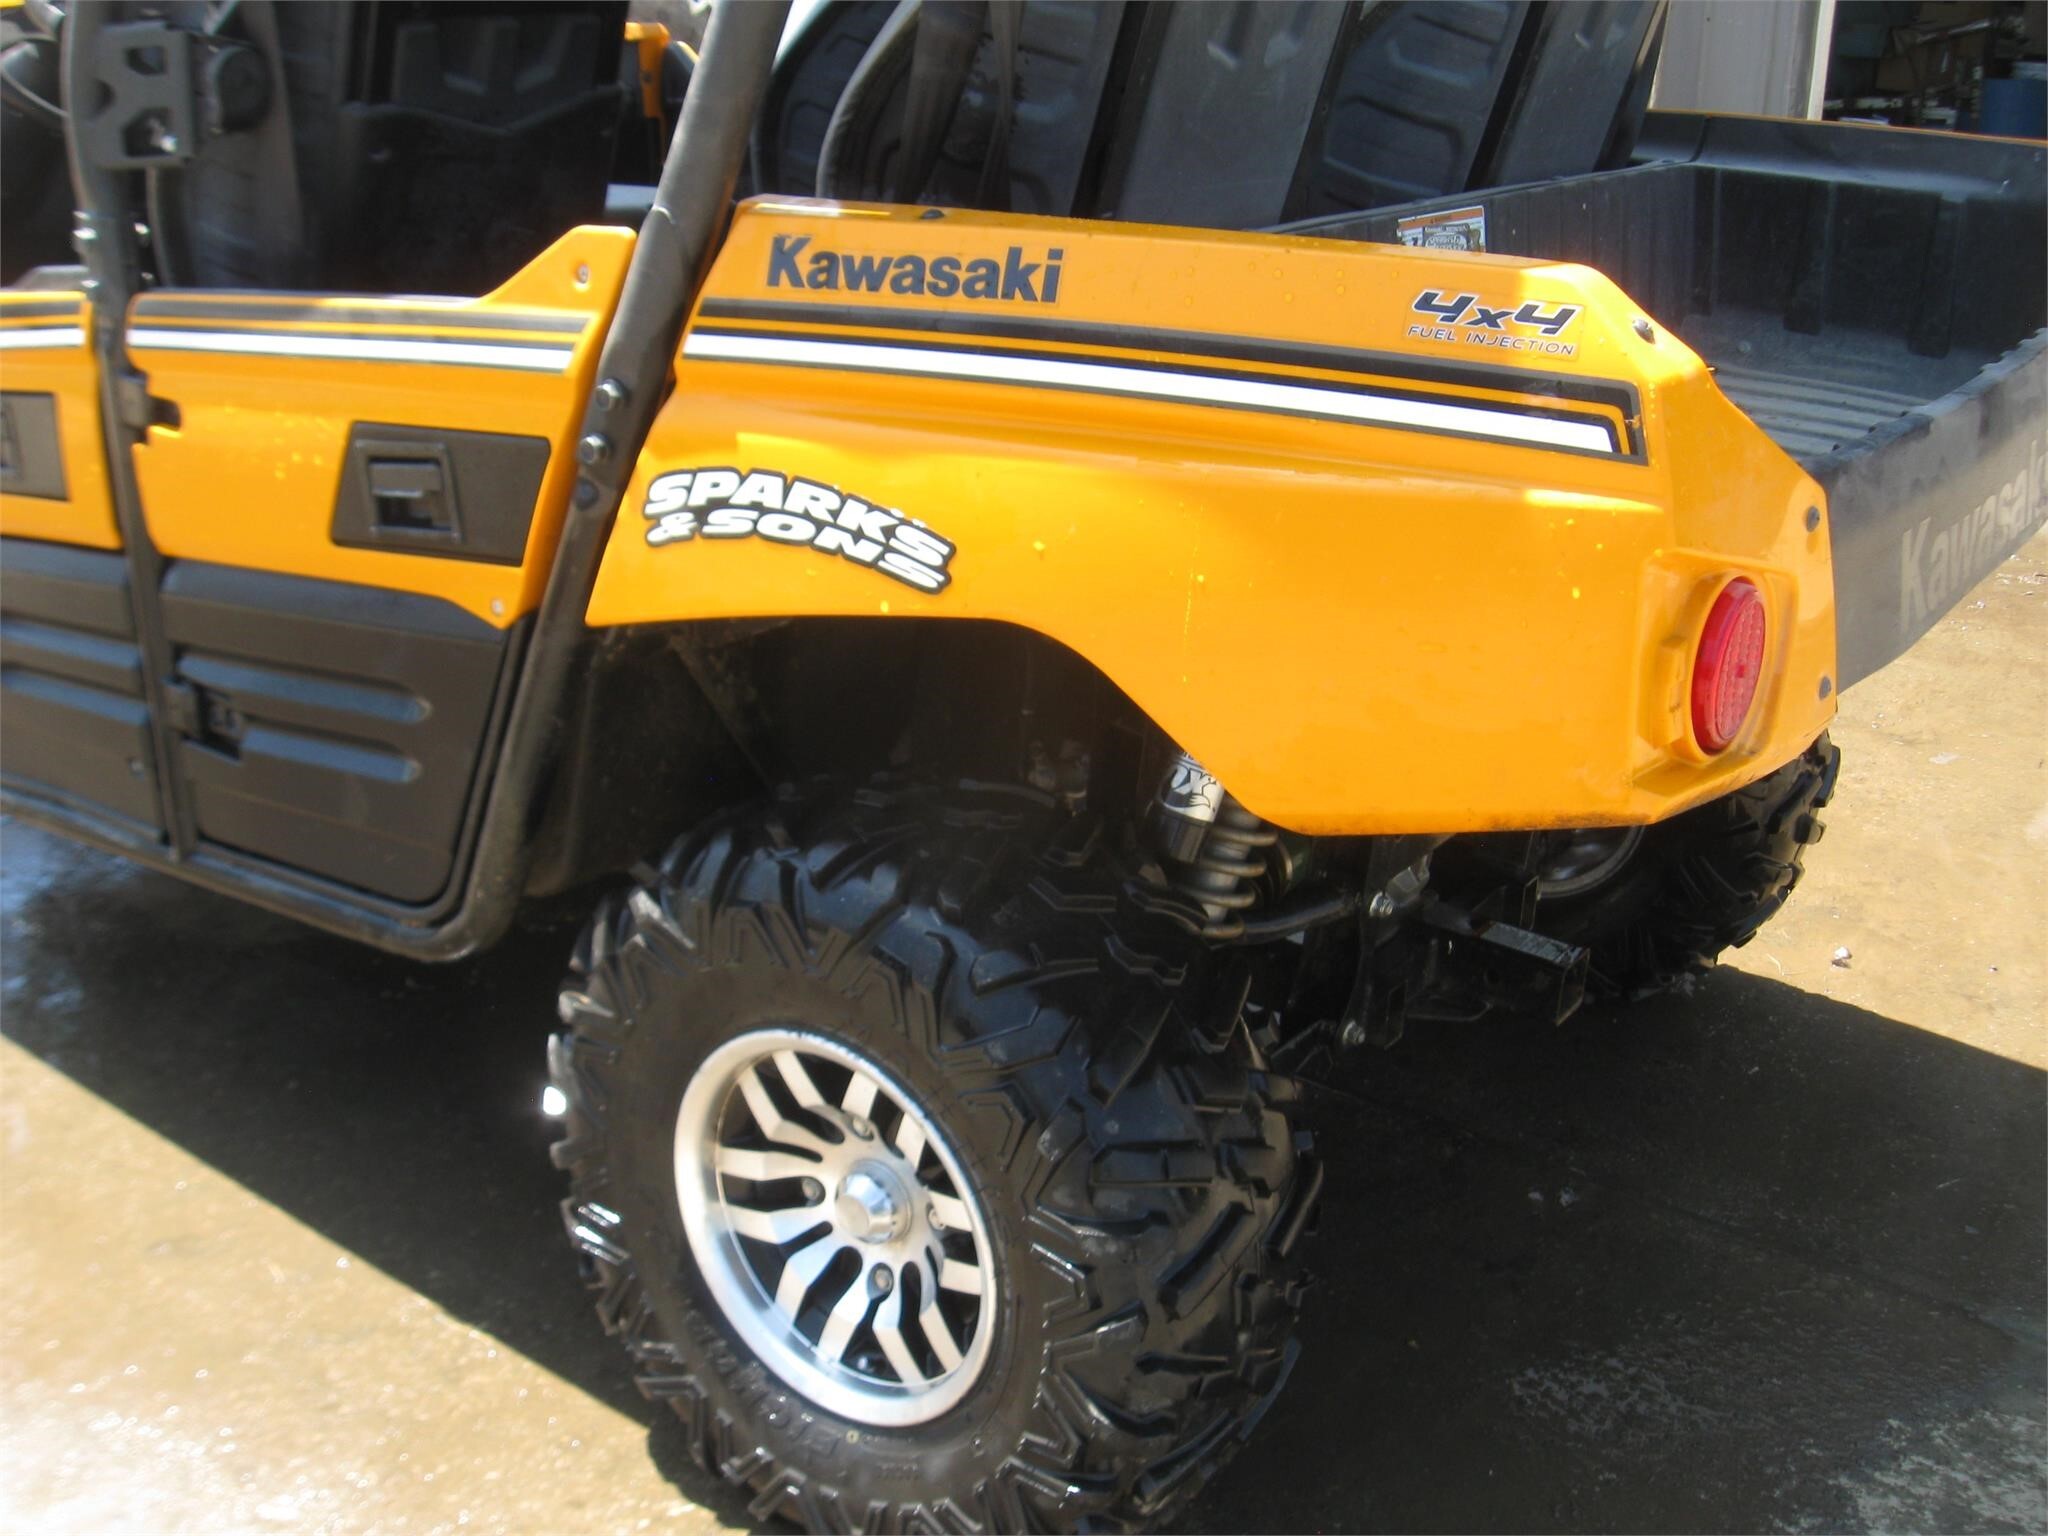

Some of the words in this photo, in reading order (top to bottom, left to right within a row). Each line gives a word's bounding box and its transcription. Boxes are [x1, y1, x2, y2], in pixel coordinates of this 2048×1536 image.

[766, 234, 1064, 303] Kawasaki
[1408, 326, 1457, 341] FUEL
[1466, 332, 1574, 355] INJECTION
[1413, 290, 1580, 336] 4x4
[644, 470, 952, 567] SPARKS
[646, 511, 697, 545] &
[702, 508, 946, 590] SONS
